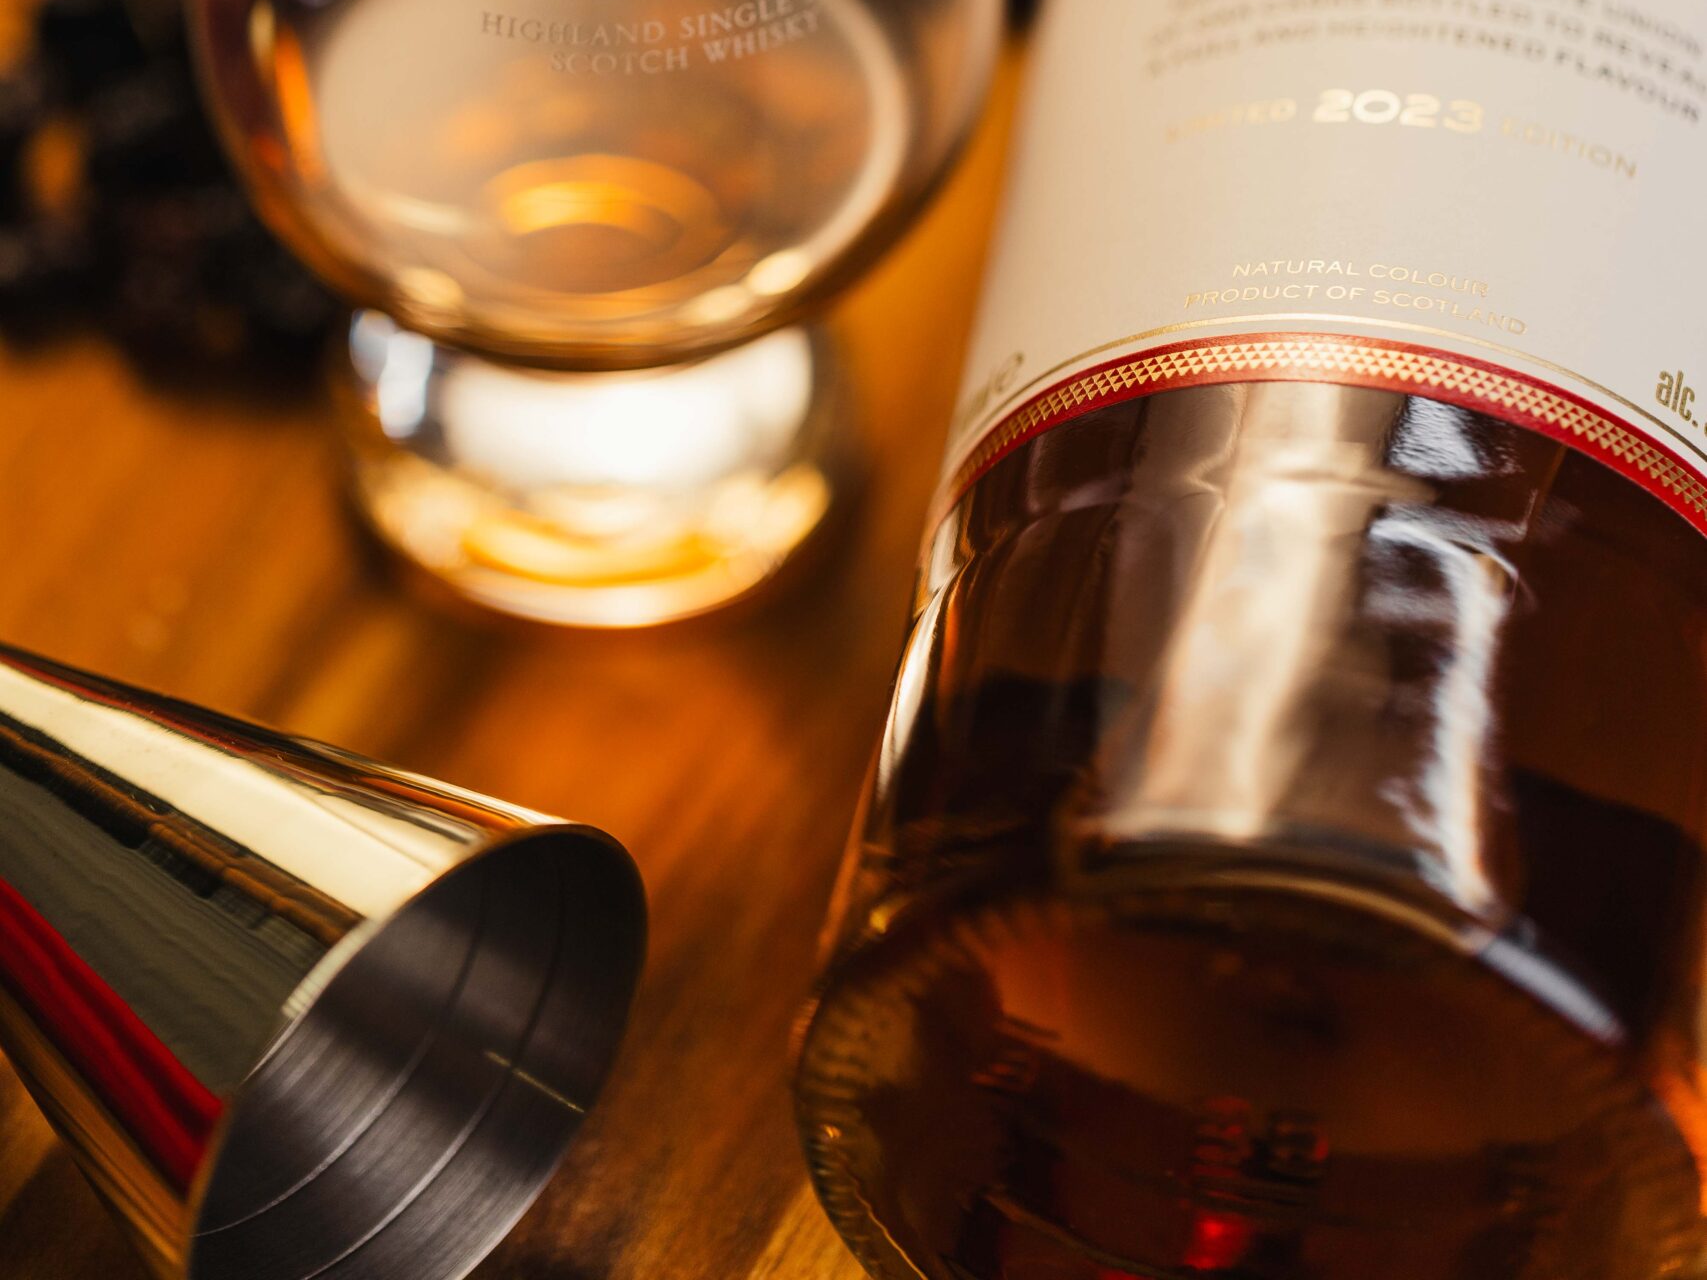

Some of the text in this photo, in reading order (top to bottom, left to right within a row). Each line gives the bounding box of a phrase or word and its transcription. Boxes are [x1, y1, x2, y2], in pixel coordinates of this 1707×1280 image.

[481, 11, 666, 48] HIGHLAND
[551, 8, 821, 75] SCOTCH WHISKY
[1312, 88, 1485, 134] 2023
[1499, 116, 1640, 180] EDITION
[1232, 259, 1490, 298] NATURAL COLOUR
[1183, 284, 1529, 336] PRODUCT OF SCOTLAND
[1655, 369, 1699, 429] alc.
